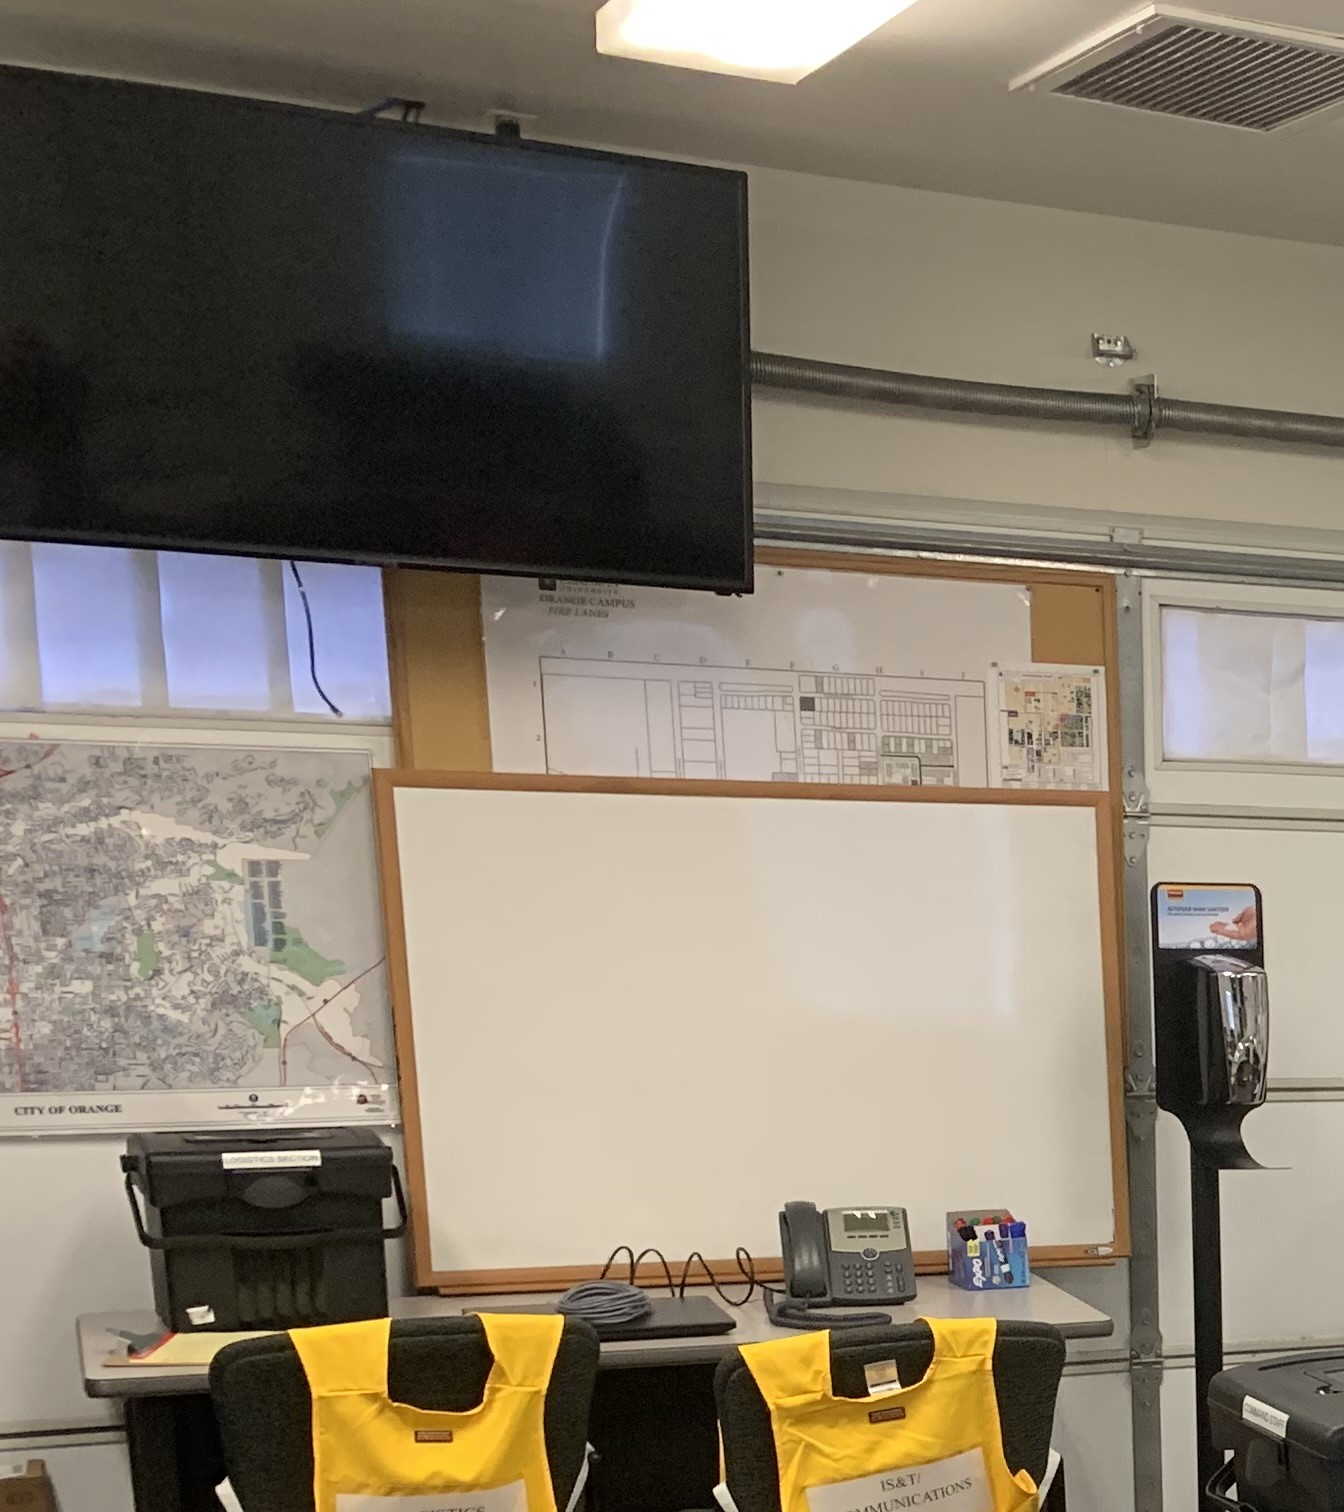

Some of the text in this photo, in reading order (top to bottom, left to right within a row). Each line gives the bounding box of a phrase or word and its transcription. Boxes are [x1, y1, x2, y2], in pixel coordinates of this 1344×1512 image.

[14, 1104, 122, 1116] CITY OF ORANGE
